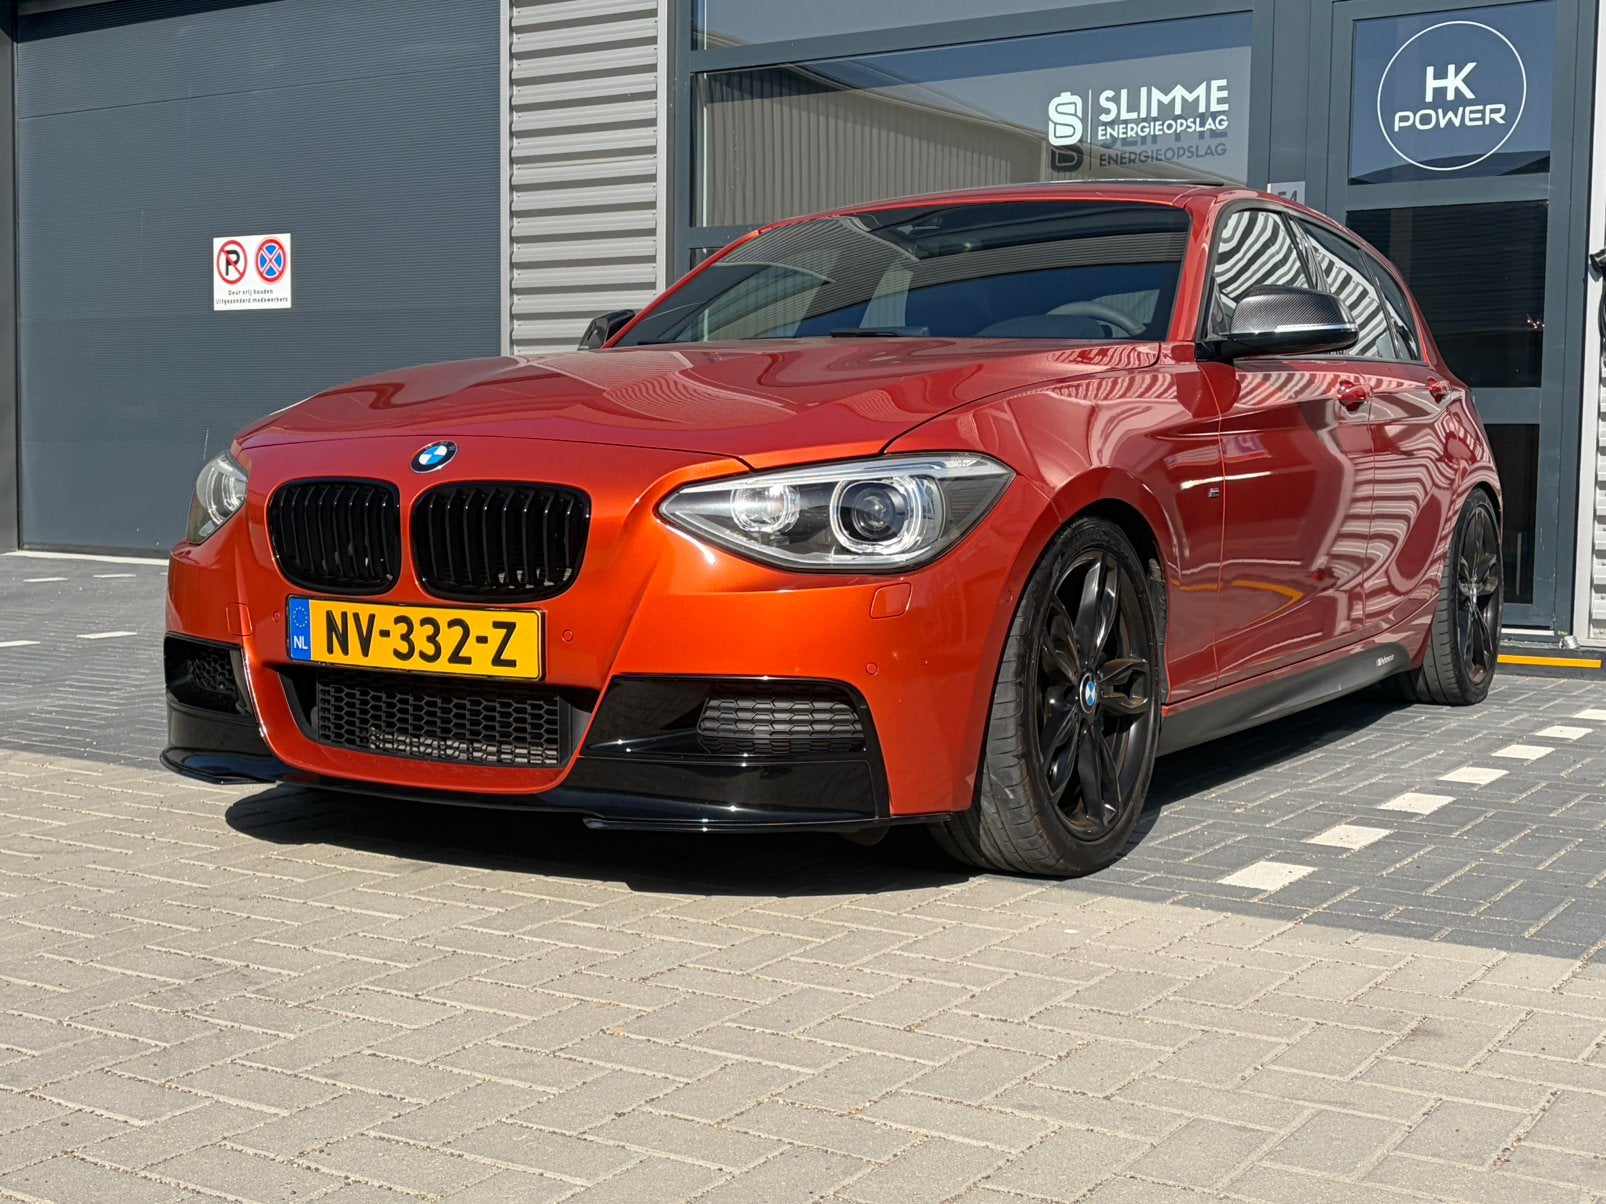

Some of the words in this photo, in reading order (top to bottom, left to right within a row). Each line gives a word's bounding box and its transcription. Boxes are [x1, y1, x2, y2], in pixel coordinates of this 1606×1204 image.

[1425, 61, 1478, 103] HK
[1098, 78, 1229, 123] SLIMME
[1394, 103, 1507, 132] POWER
[1097, 115, 1229, 141] ENERGIEOPSLAG
[293, 635, 309, 650] NL
[325, 609, 518, 668] NV-332-Z
